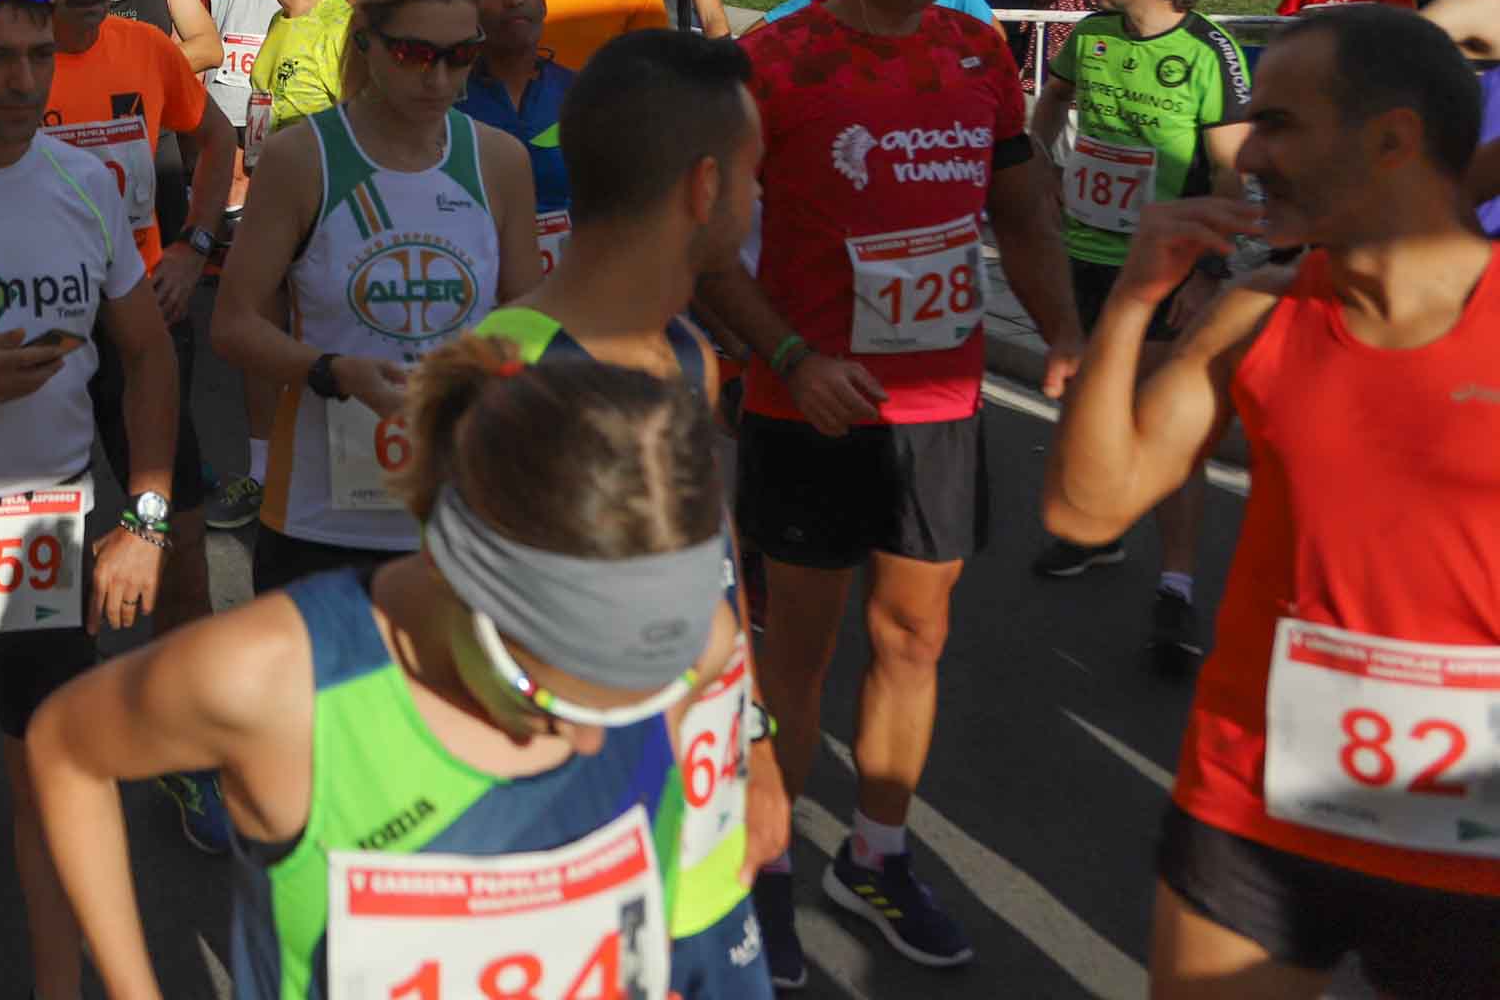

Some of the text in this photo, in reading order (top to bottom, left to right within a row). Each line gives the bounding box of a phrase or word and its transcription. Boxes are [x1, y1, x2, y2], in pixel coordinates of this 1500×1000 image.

[1076, 167, 1141, 211] 187
[878, 264, 975, 327] 128
[1339, 707, 1468, 798] 82
